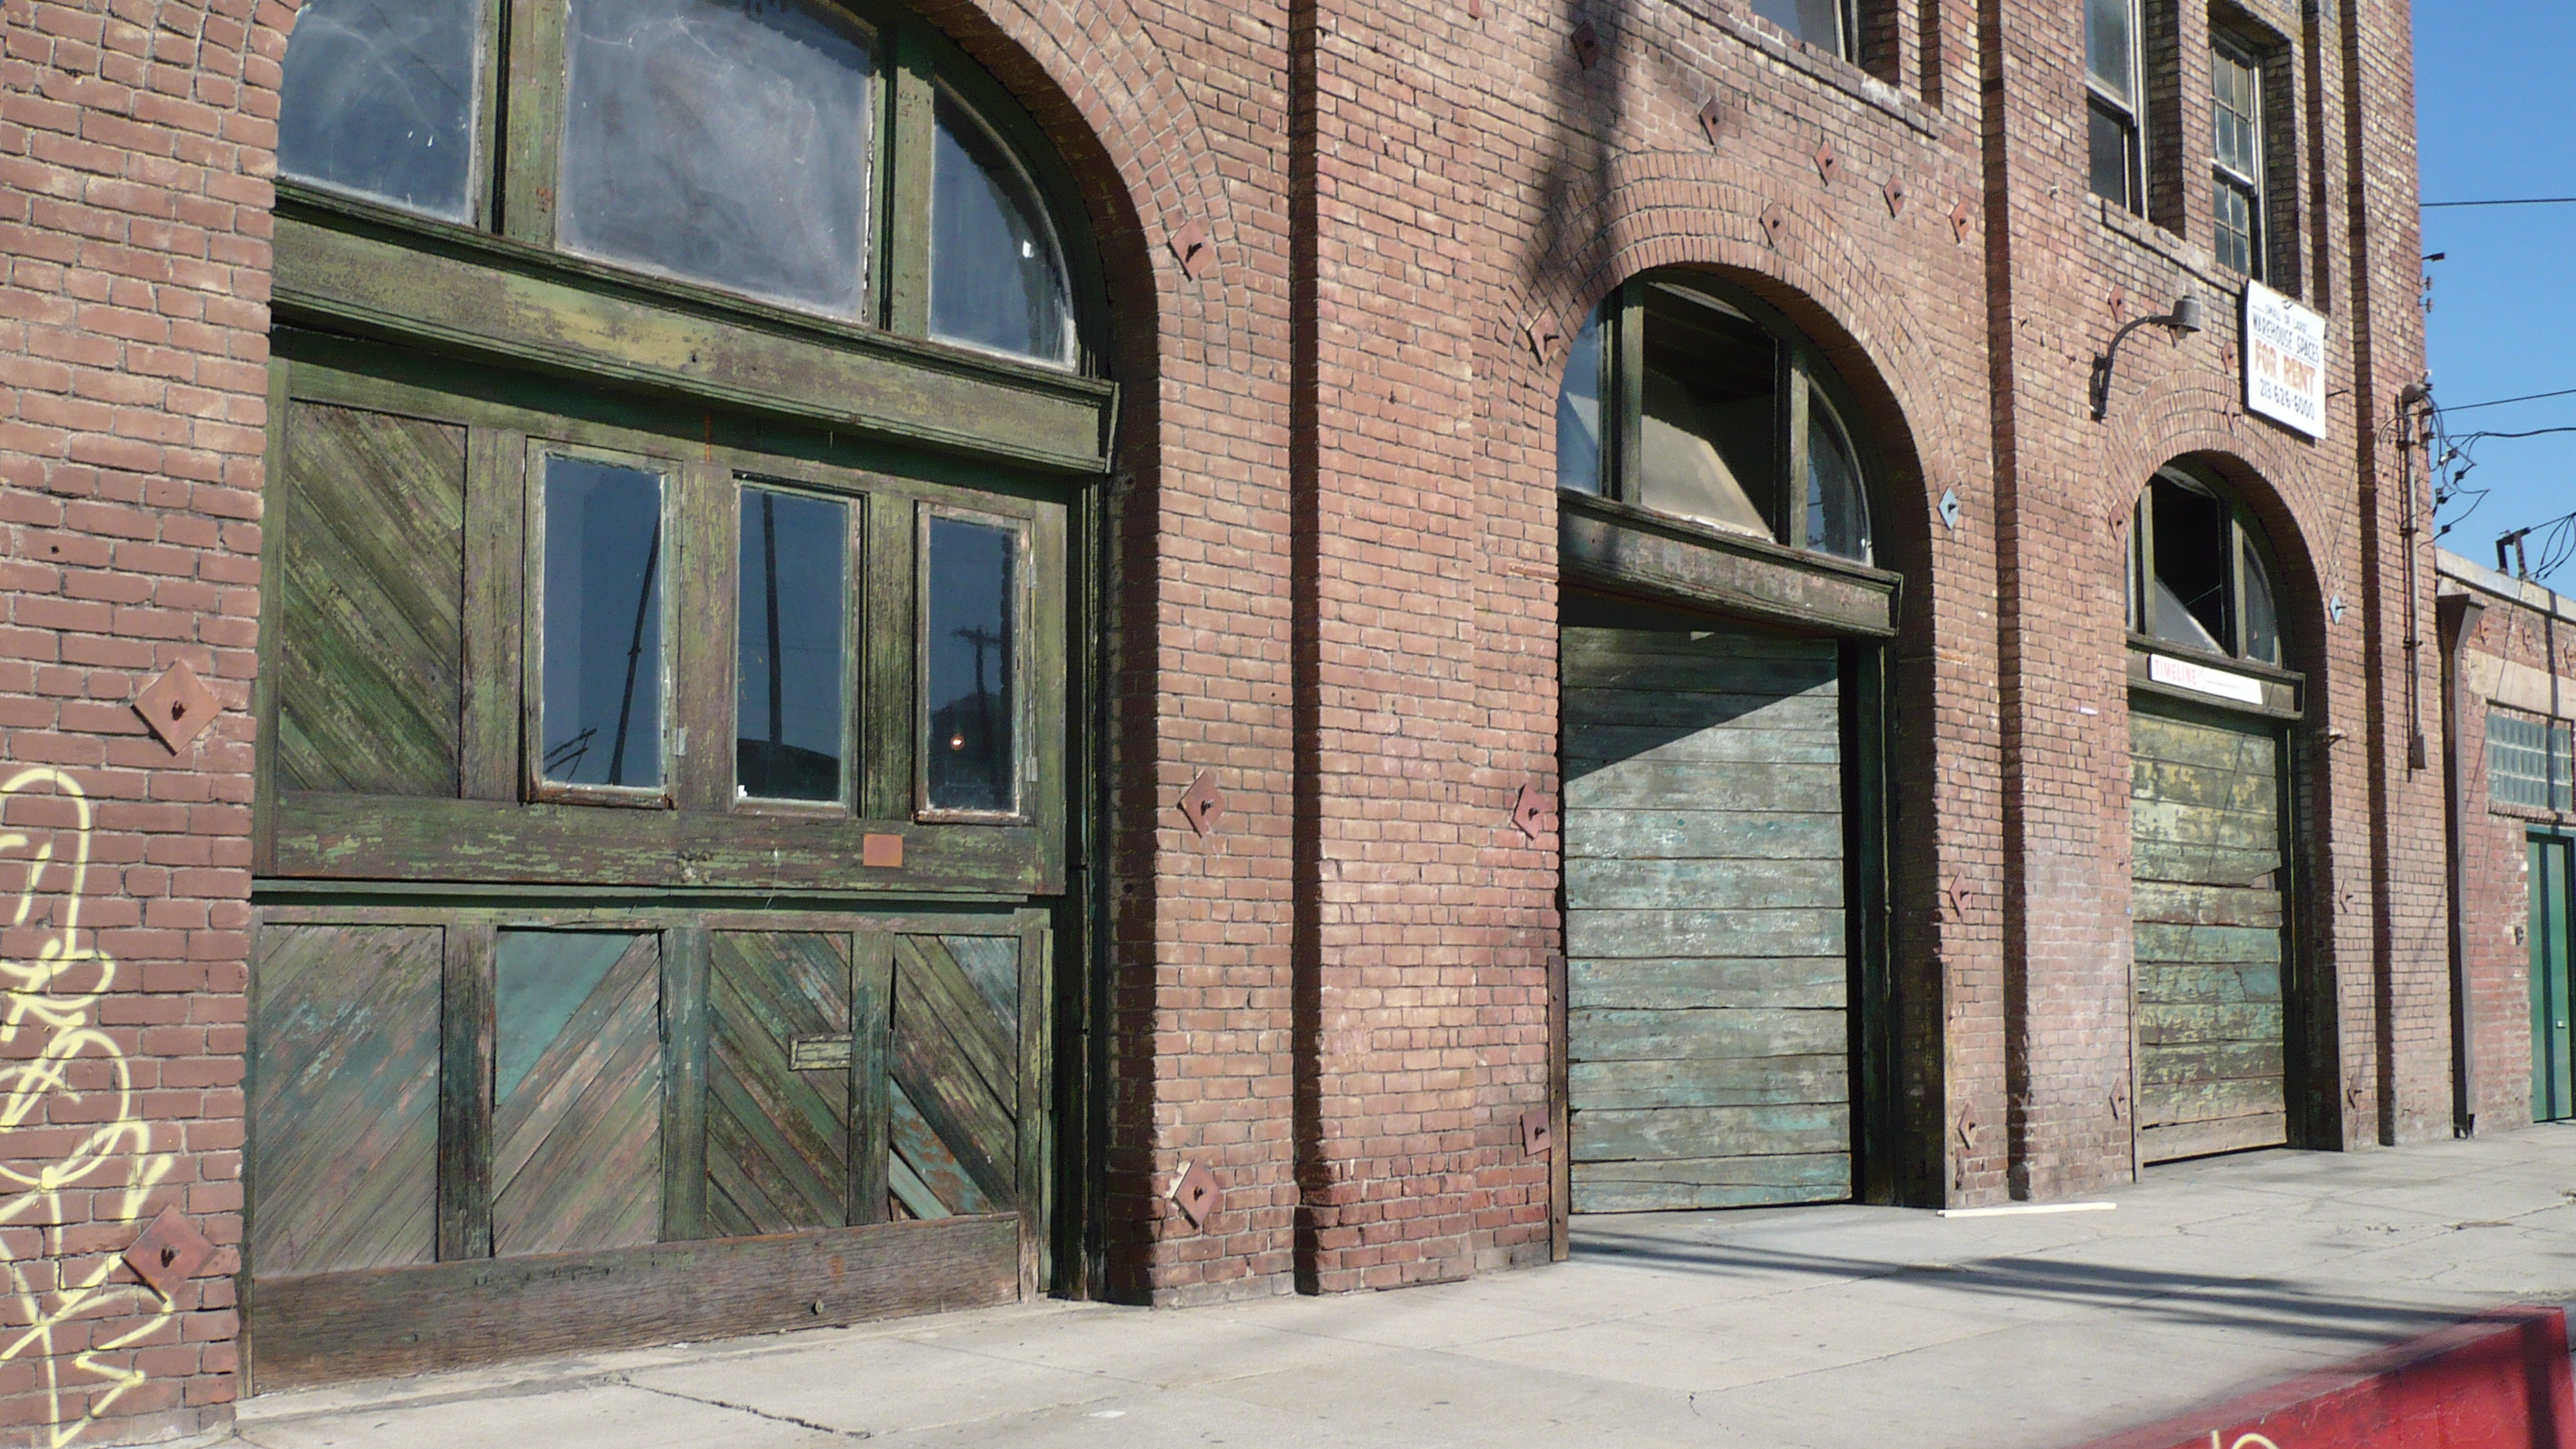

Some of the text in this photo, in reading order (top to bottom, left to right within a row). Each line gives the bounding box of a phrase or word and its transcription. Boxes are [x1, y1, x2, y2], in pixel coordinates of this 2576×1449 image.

[2265, 304, 2282, 322] SMALL
[2252, 312, 2320, 364] WAREHOUSE SPACES
[2255, 339, 2316, 397] FOR RENT
[2259, 378, 2315, 421] 213 626-6000
[2154, 659, 2197, 685] TIMELINE
